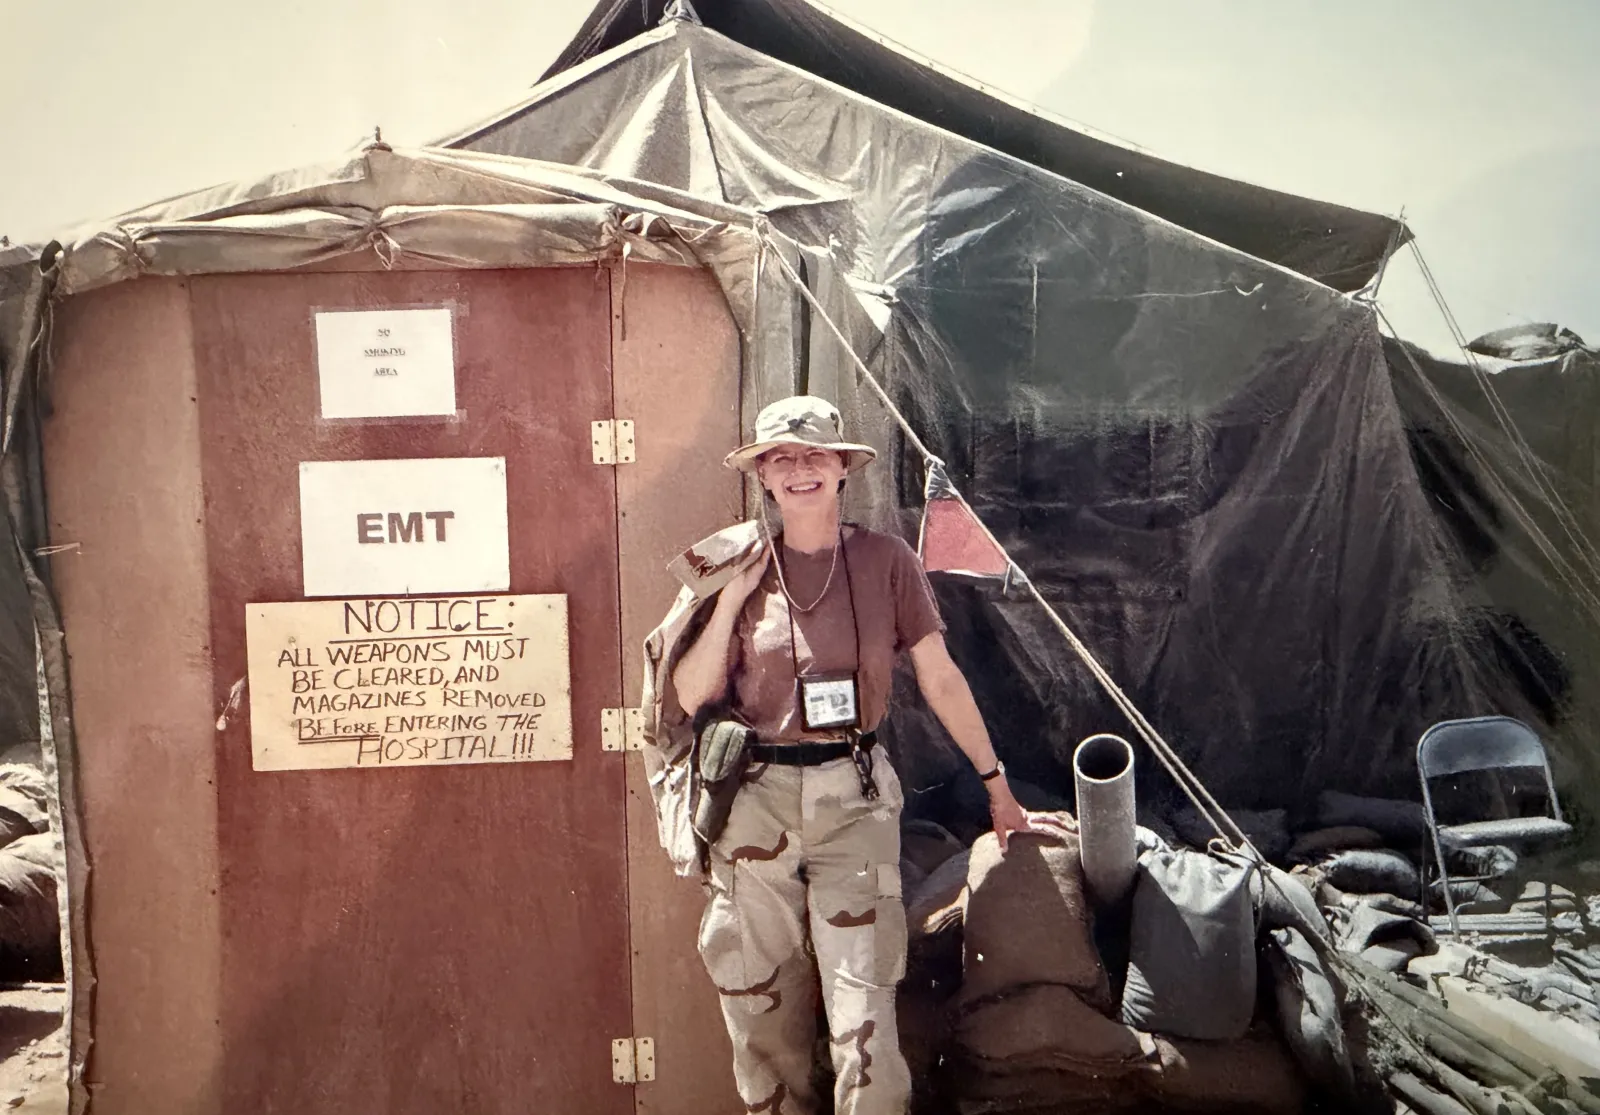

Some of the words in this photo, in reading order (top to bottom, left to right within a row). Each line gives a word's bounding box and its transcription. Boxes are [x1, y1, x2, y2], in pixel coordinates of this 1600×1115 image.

[357, 511, 455, 544] EMT
[344, 599, 515, 634] NOTICE:
[278, 647, 319, 668] ALL
[326, 641, 451, 665] WEAPONS
[463, 638, 530, 661] MUST
[292, 669, 326, 693] BE
[293, 690, 426, 715] MAGAZINES
[442, 689, 546, 708] REMOVED
[384, 714, 488, 733] ENTERING
[497, 713, 542, 731] THE
